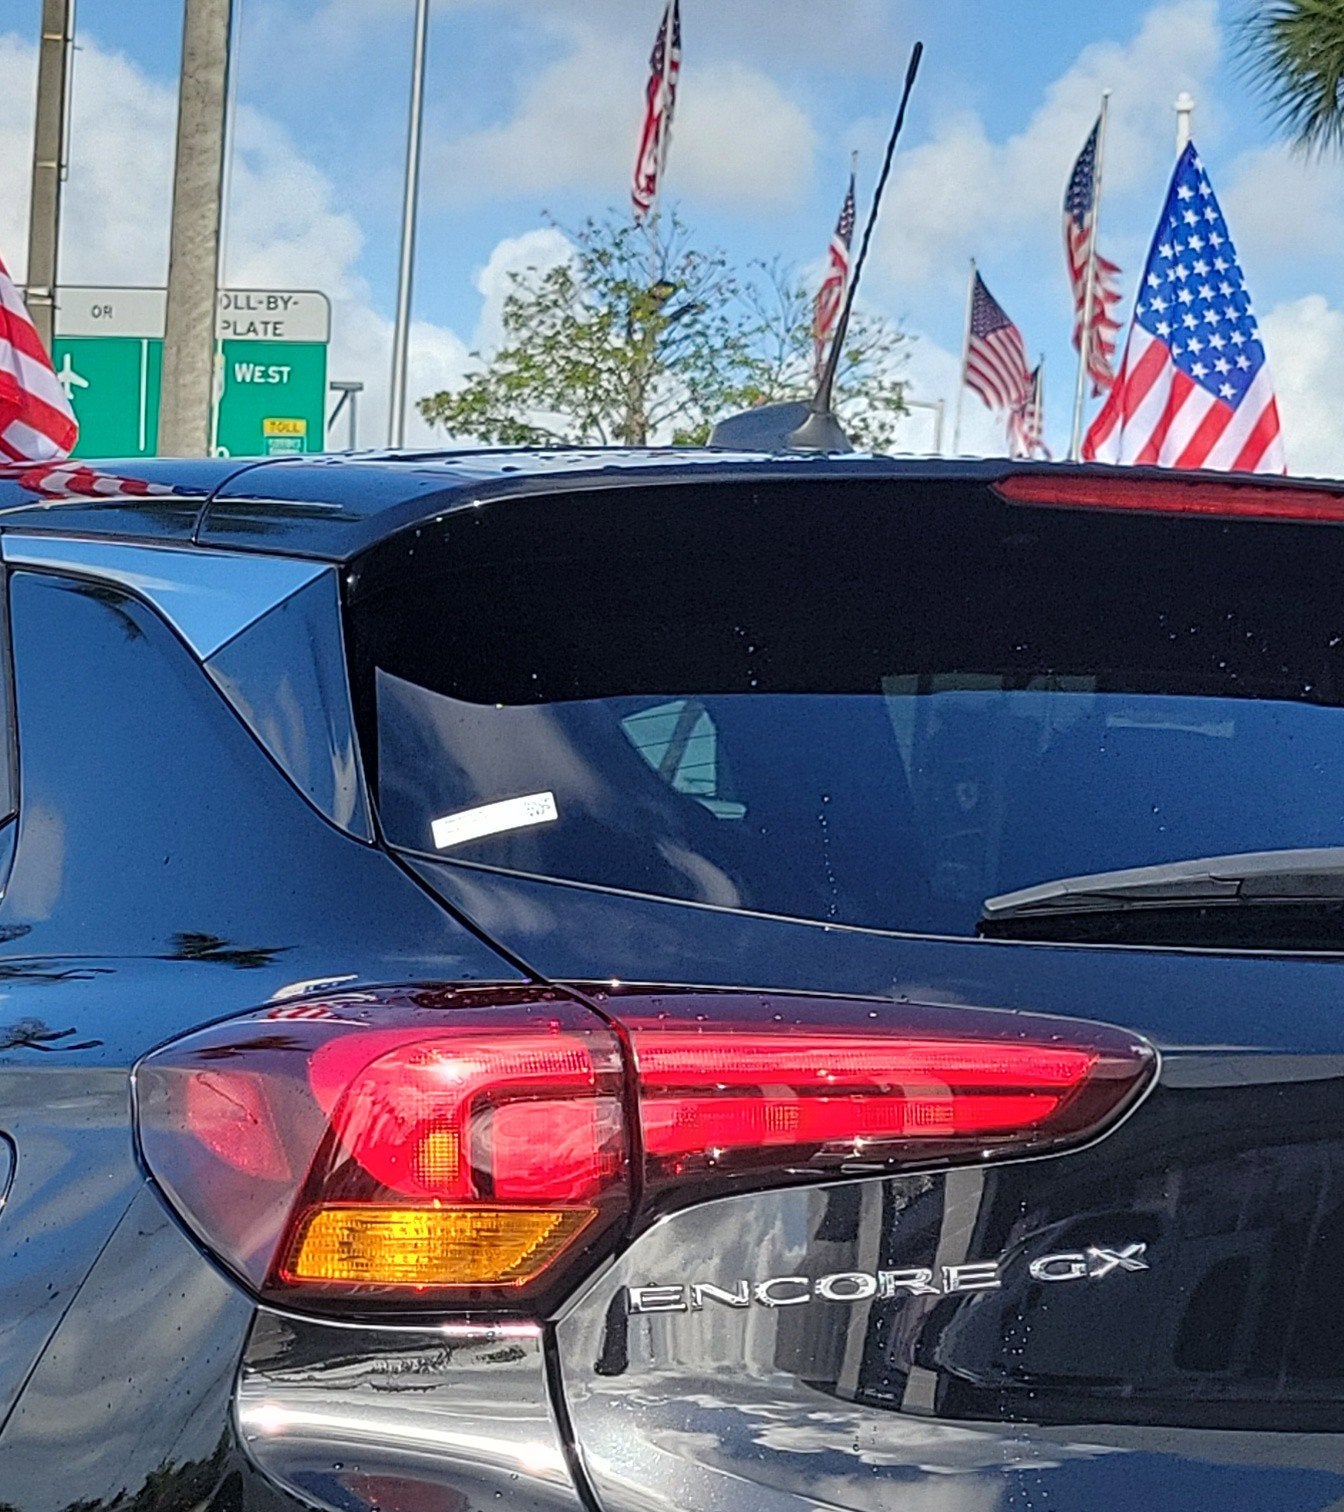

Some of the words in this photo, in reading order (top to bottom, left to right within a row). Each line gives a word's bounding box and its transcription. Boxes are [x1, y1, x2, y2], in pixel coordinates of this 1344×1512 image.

[220, 293, 299, 311] OLL-BY-
[91, 304, 113, 319] OR
[220, 320, 285, 337] PLATE
[234, 362, 292, 384] WEST
[627, 1263, 1002, 1316] ENCORE
[1029, 1242, 1150, 1281] GX
